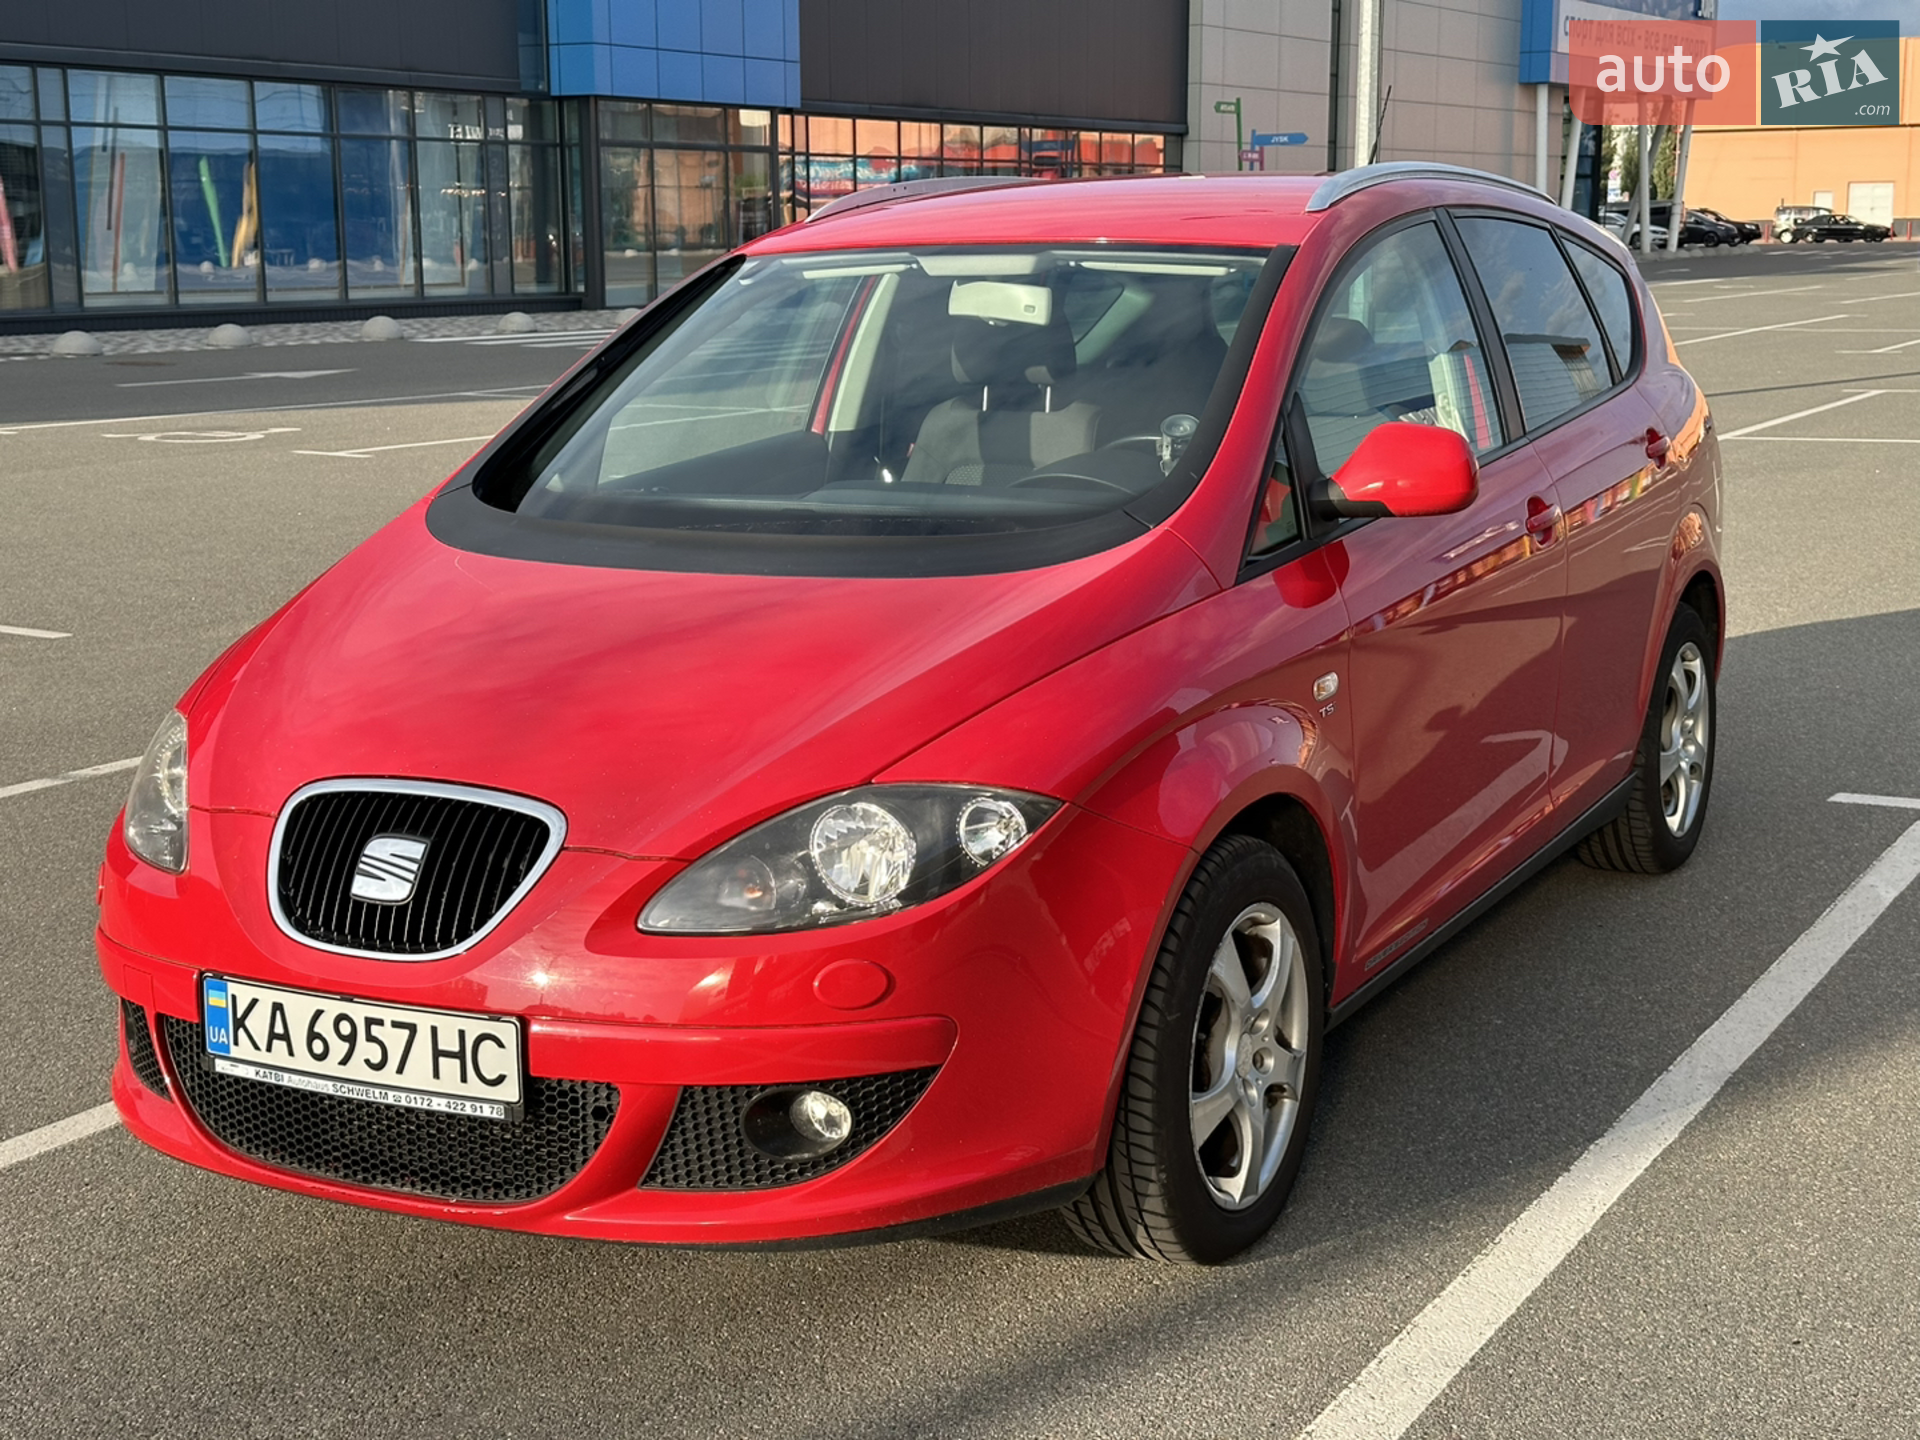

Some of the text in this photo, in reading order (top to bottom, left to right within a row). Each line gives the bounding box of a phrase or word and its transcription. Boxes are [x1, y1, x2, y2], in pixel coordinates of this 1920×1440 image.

[209, 1025, 228, 1044] UA
[231, 993, 507, 1087] KA 6957 HC
[254, 1069, 284, 1083] KATBI
[287, 1075, 330, 1092] Autohaus
[332, 1083, 389, 1101] SCHWELM
[405, 1094, 433, 1108] 0172
[445, 1100, 467, 1113] 422
[470, 1103, 483, 1114] 91
[488, 1105, 504, 1117] 78
